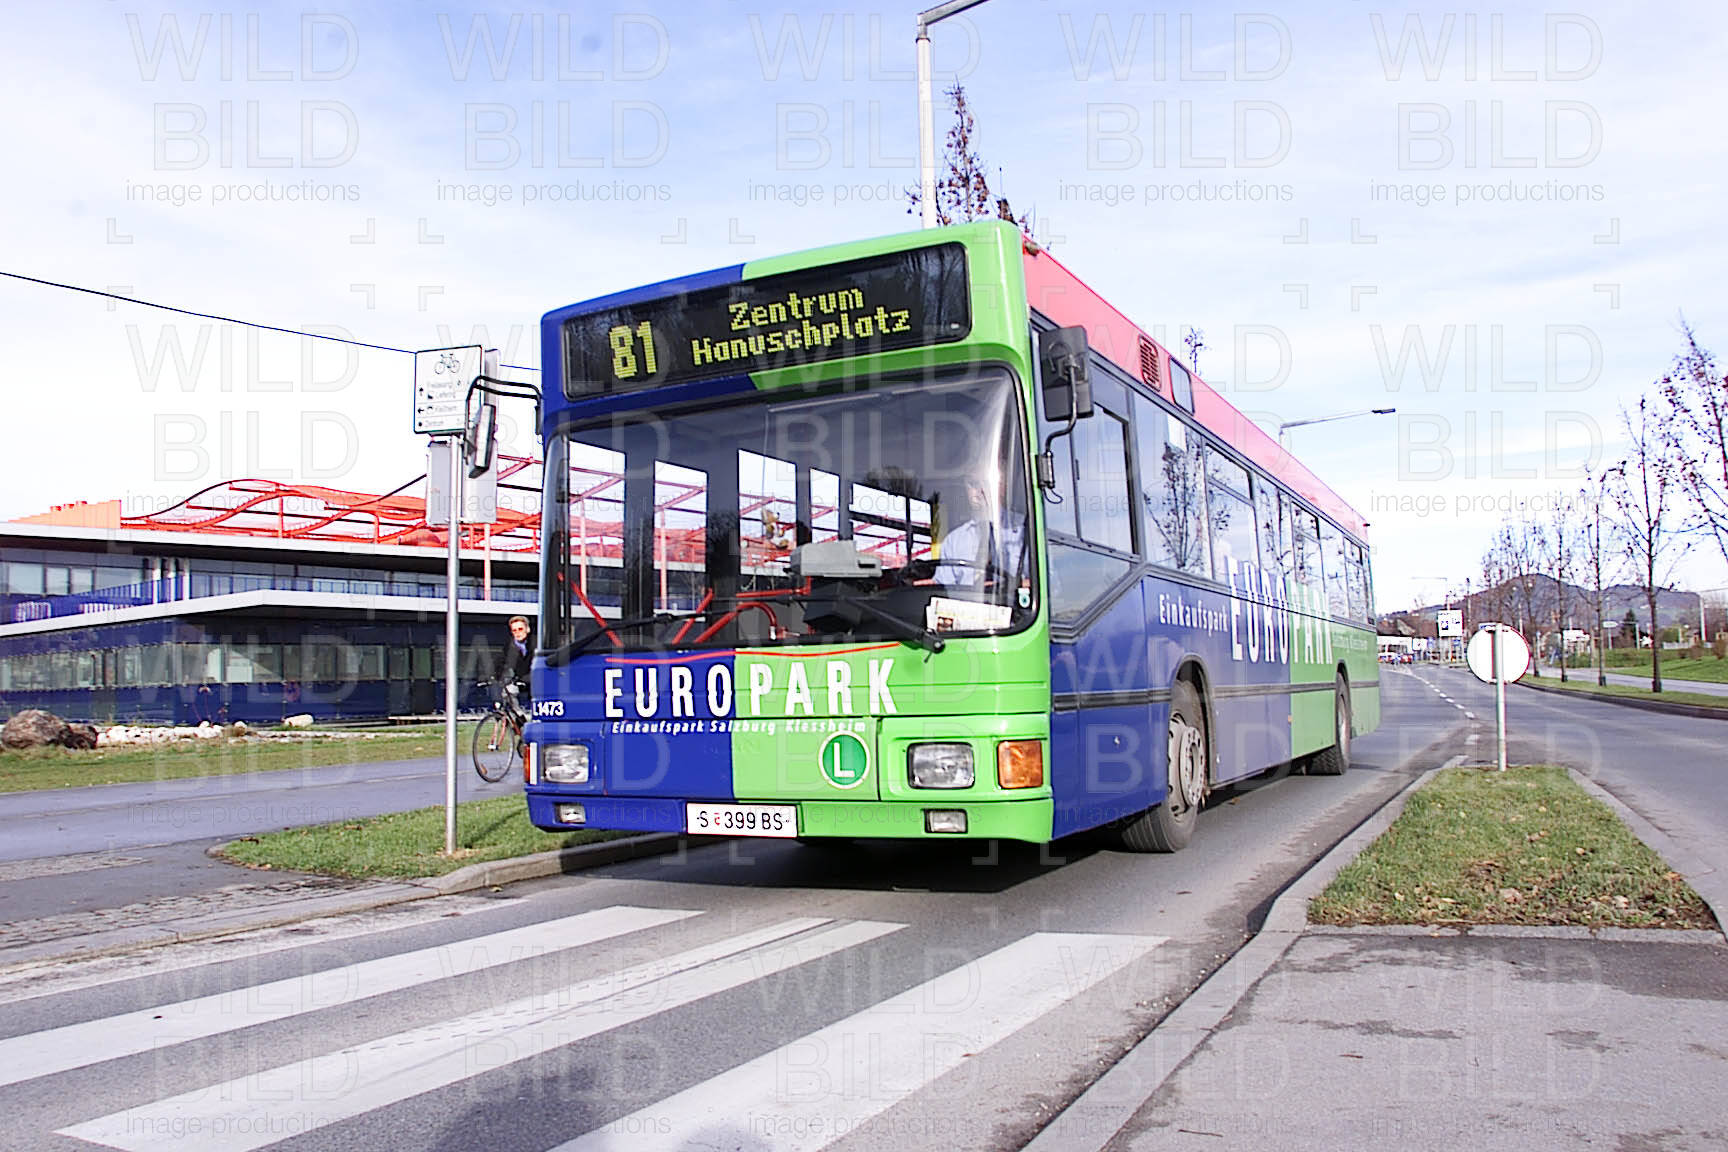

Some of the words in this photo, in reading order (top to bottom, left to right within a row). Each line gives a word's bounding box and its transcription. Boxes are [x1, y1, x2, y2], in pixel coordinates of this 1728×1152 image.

[728, 287, 866, 331] Zentrum
[608, 321, 659, 379] 81
[691, 306, 912, 366] Hanuschplatz
[1159, 593, 1229, 638] Einkaufspark
[604, 658, 898, 718] EUROPARK
[612, 720, 704, 736] Einkaufspark
[709, 719, 776, 736] Salzburg
[833, 742, 856, 779] L
